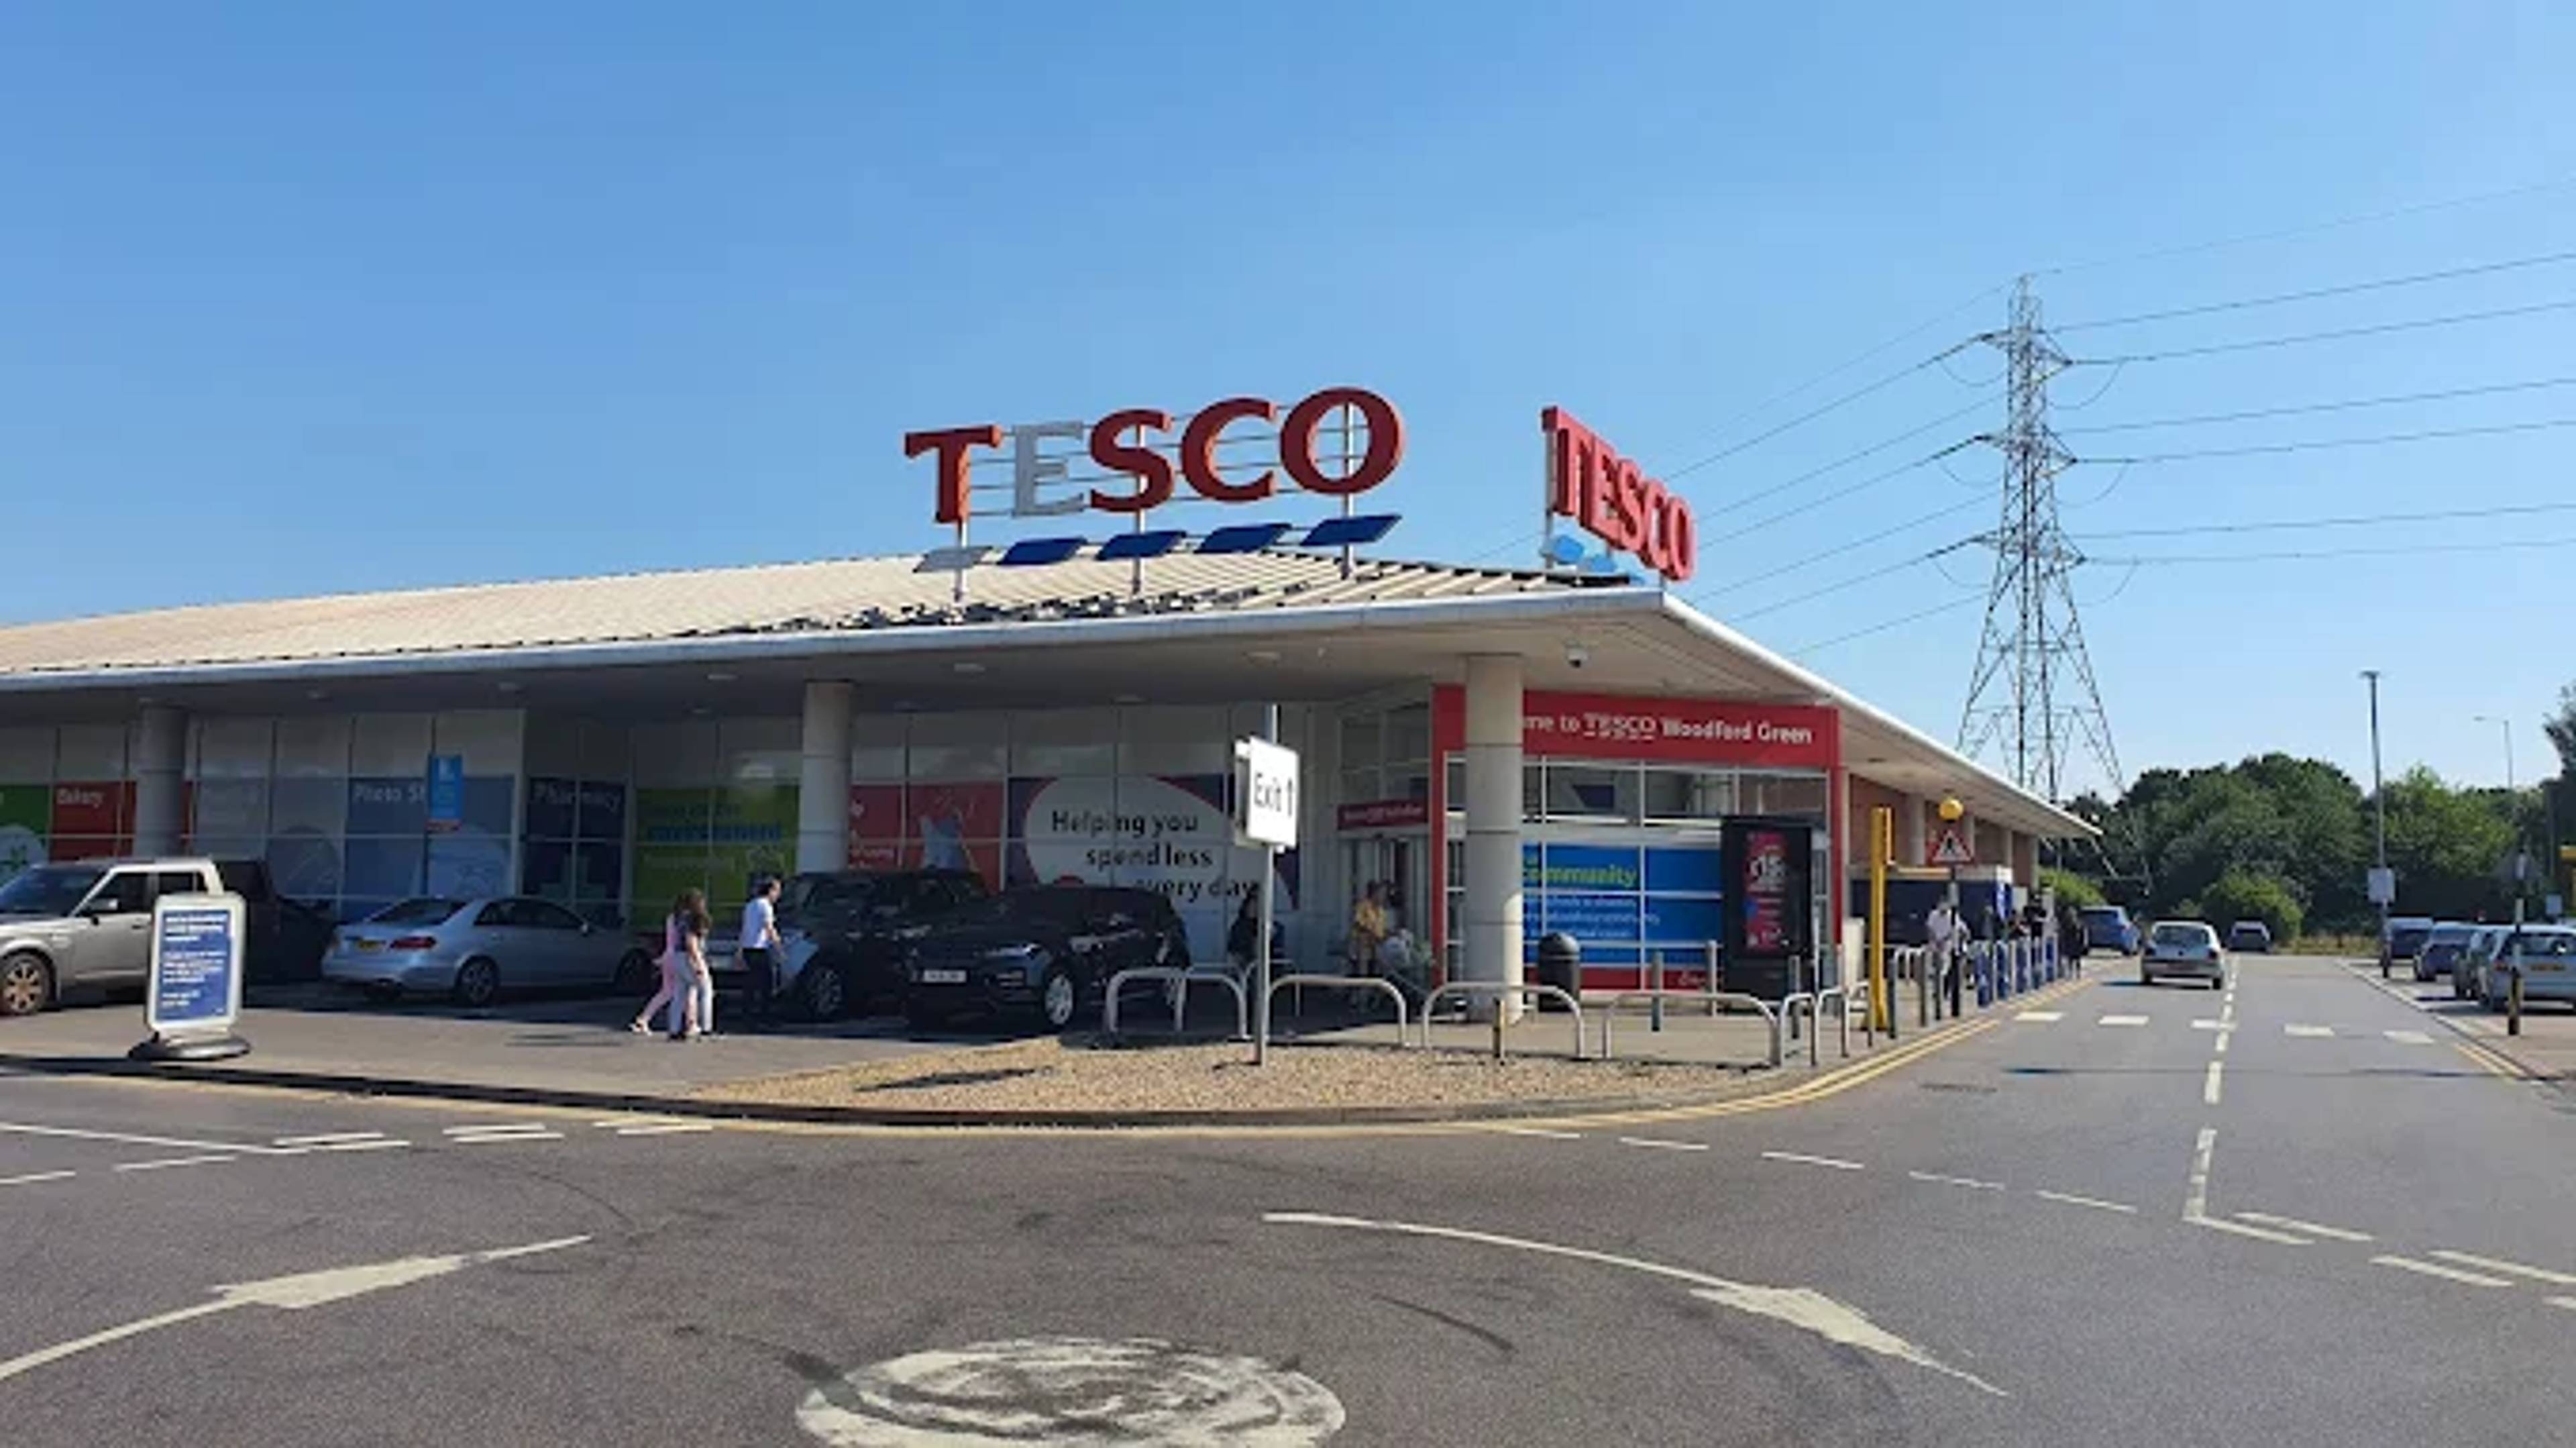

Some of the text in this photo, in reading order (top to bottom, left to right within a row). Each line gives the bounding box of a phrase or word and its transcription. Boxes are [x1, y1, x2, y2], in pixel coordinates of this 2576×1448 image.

[904, 386, 1405, 523] TESCO
[1542, 405, 1695, 581] TESCO
[1560, 713, 1581, 733] to
[1582, 712, 1657, 739] TESCO
[1660, 716, 1752, 740] Woodford
[1757, 721, 1812, 744] Green
[1254, 772, 1282, 813] Exit
[1052, 810, 1198, 838] Helping you
[1085, 842, 1214, 871] spend less
